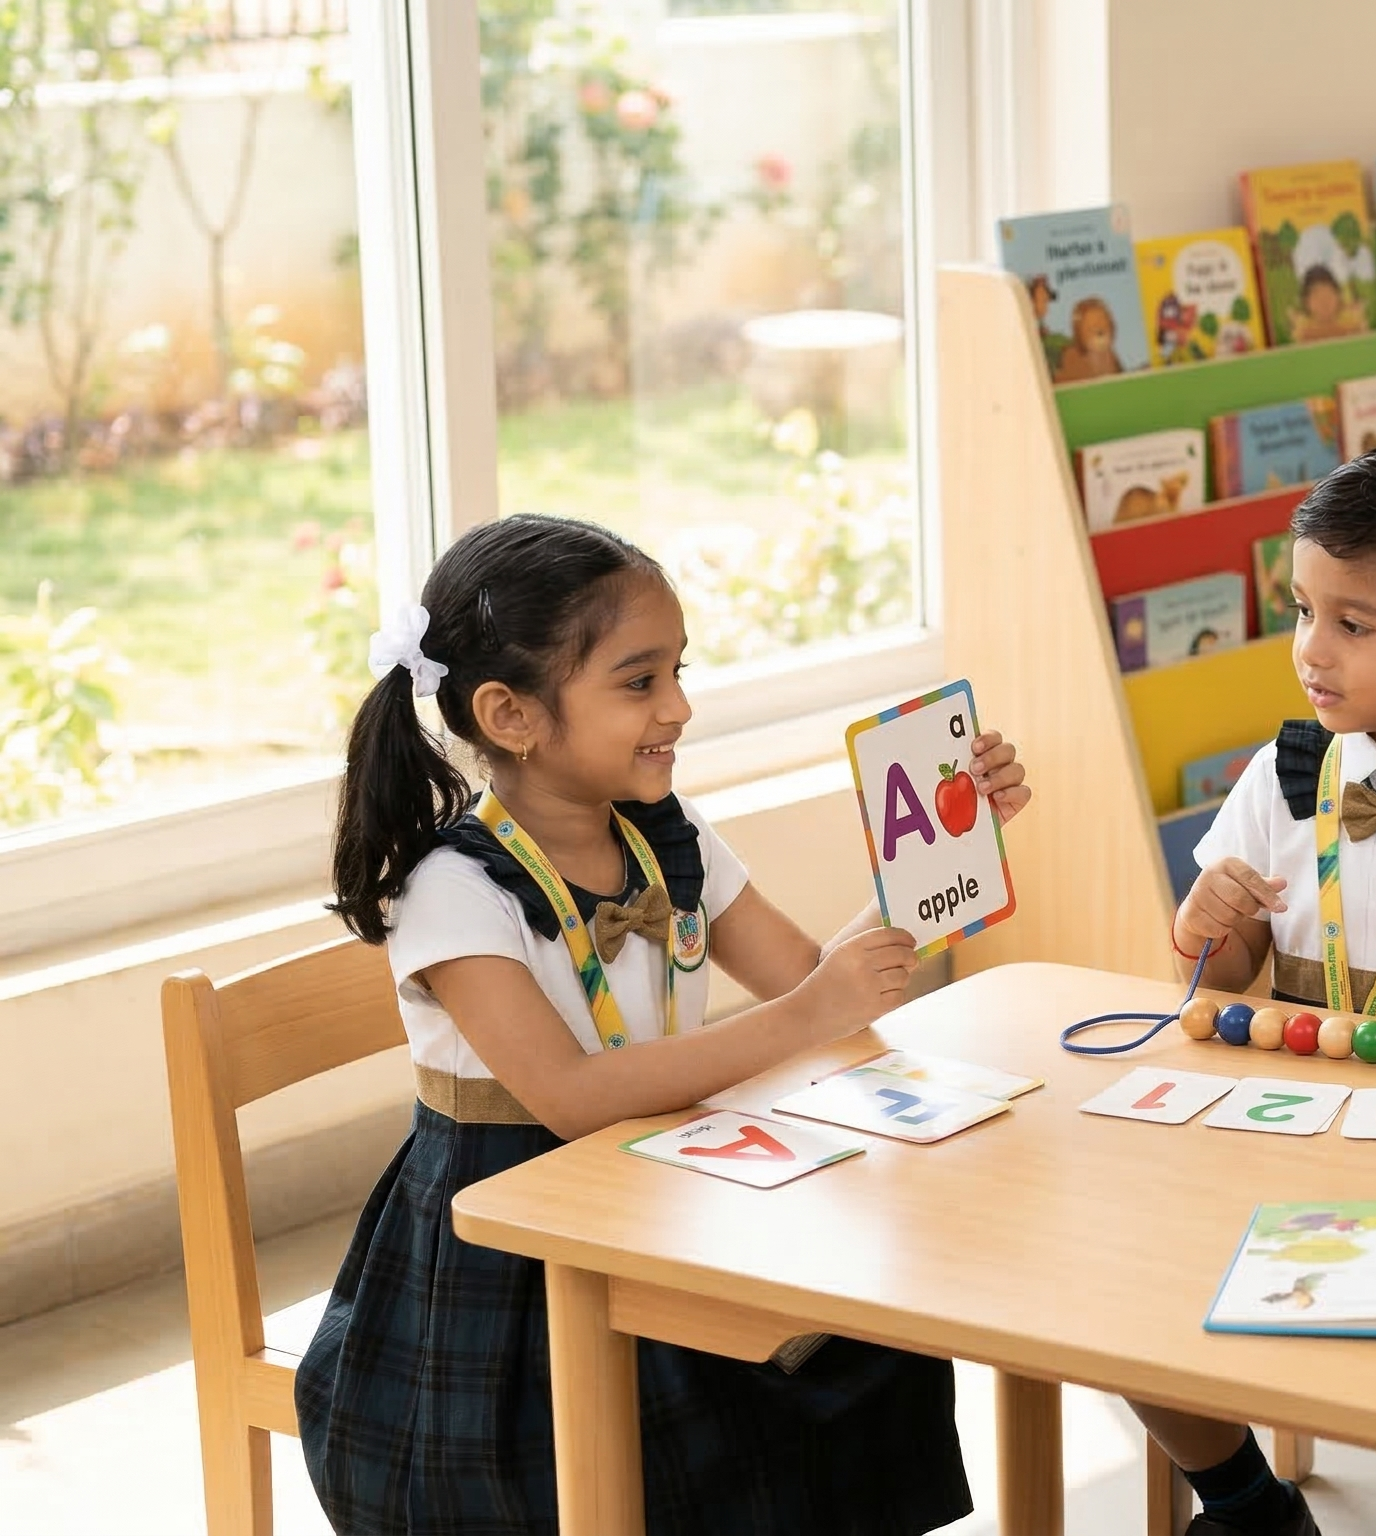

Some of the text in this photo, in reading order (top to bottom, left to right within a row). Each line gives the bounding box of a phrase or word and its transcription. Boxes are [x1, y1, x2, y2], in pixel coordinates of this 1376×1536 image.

[949, 713, 966, 738] a
[882, 762, 936, 862] A
[917, 873, 979, 924] apple
[1130, 1082, 1177, 1109] 1
[1246, 1092, 1314, 1122] 2
[678, 1125, 797, 1161] A
